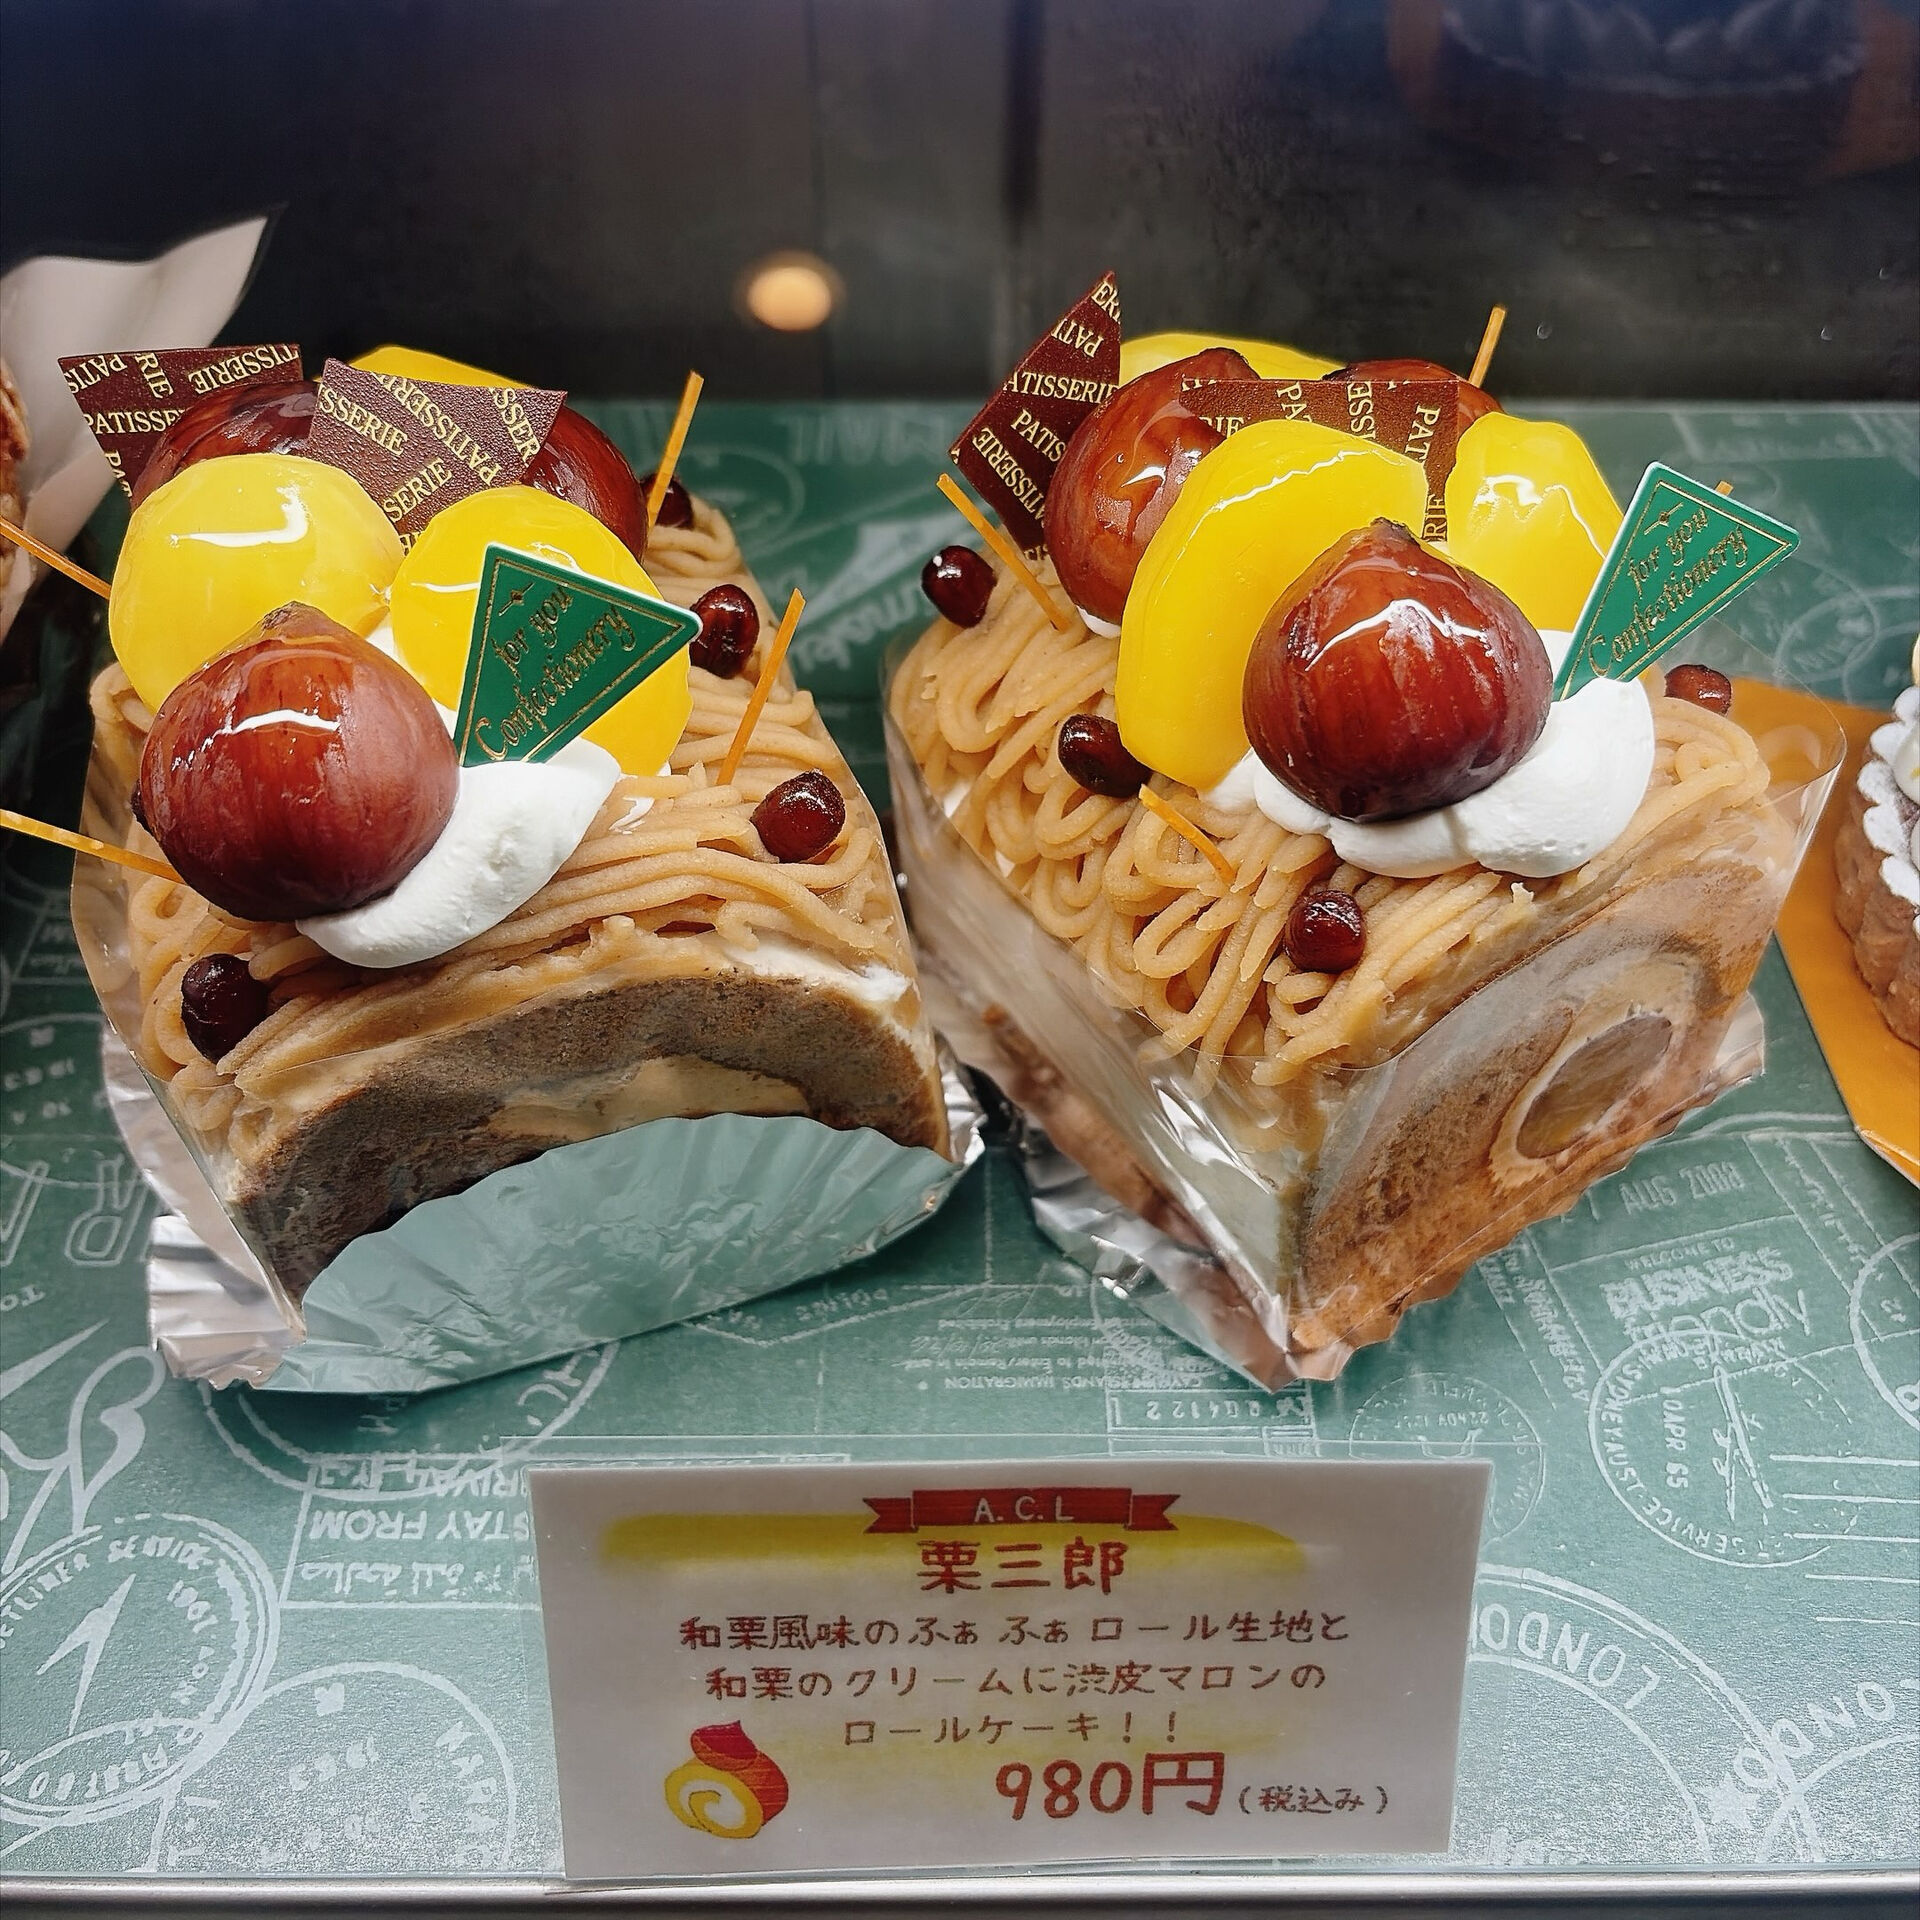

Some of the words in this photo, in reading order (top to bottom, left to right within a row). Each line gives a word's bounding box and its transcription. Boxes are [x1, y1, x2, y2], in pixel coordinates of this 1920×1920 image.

[309, 1509, 428, 1541] FROM
[916, 1536, 1128, 1595] 栗三郎
[705, 1660, 1326, 1701] 和栗のクリームに渋皮マロンの
[1471, 1602, 1660, 1710] LONDO
[995, 1752, 1225, 1820] 980円
